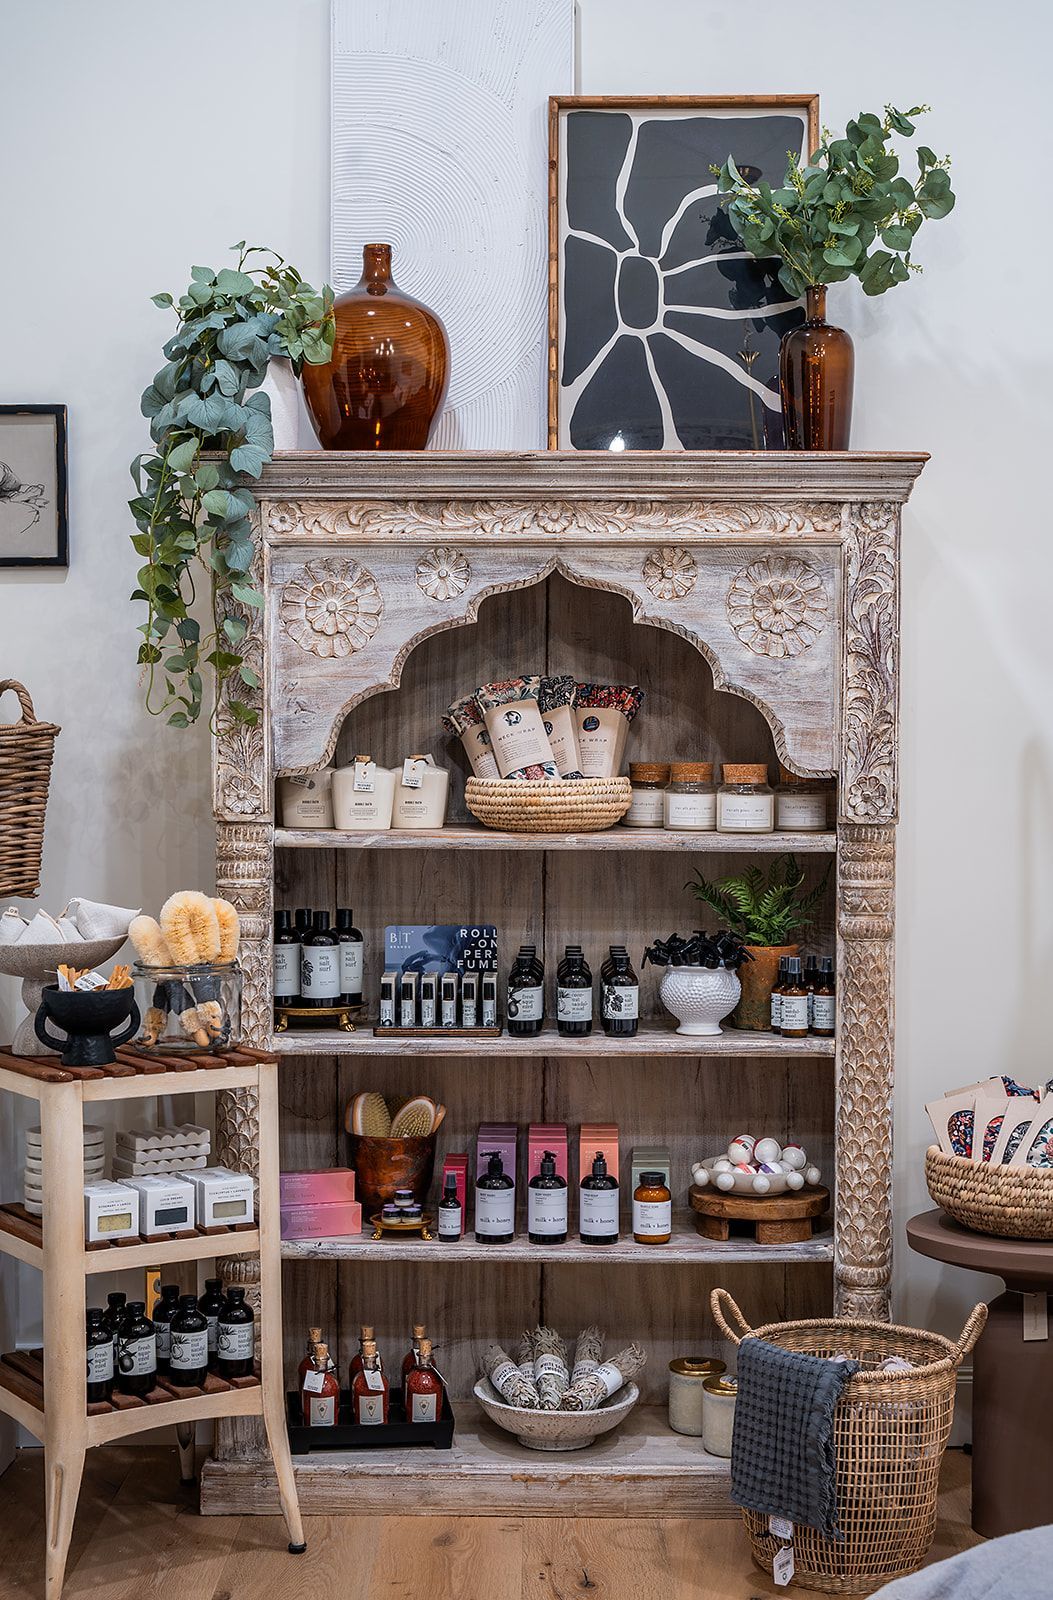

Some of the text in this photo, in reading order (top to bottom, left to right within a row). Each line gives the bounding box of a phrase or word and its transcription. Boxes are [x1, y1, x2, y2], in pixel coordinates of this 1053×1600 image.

[460, 929, 498, 938] ROLL
[471, 940, 498, 948] -ON
[464, 950, 498, 958] PER-
[457, 960, 498, 968] FUME
